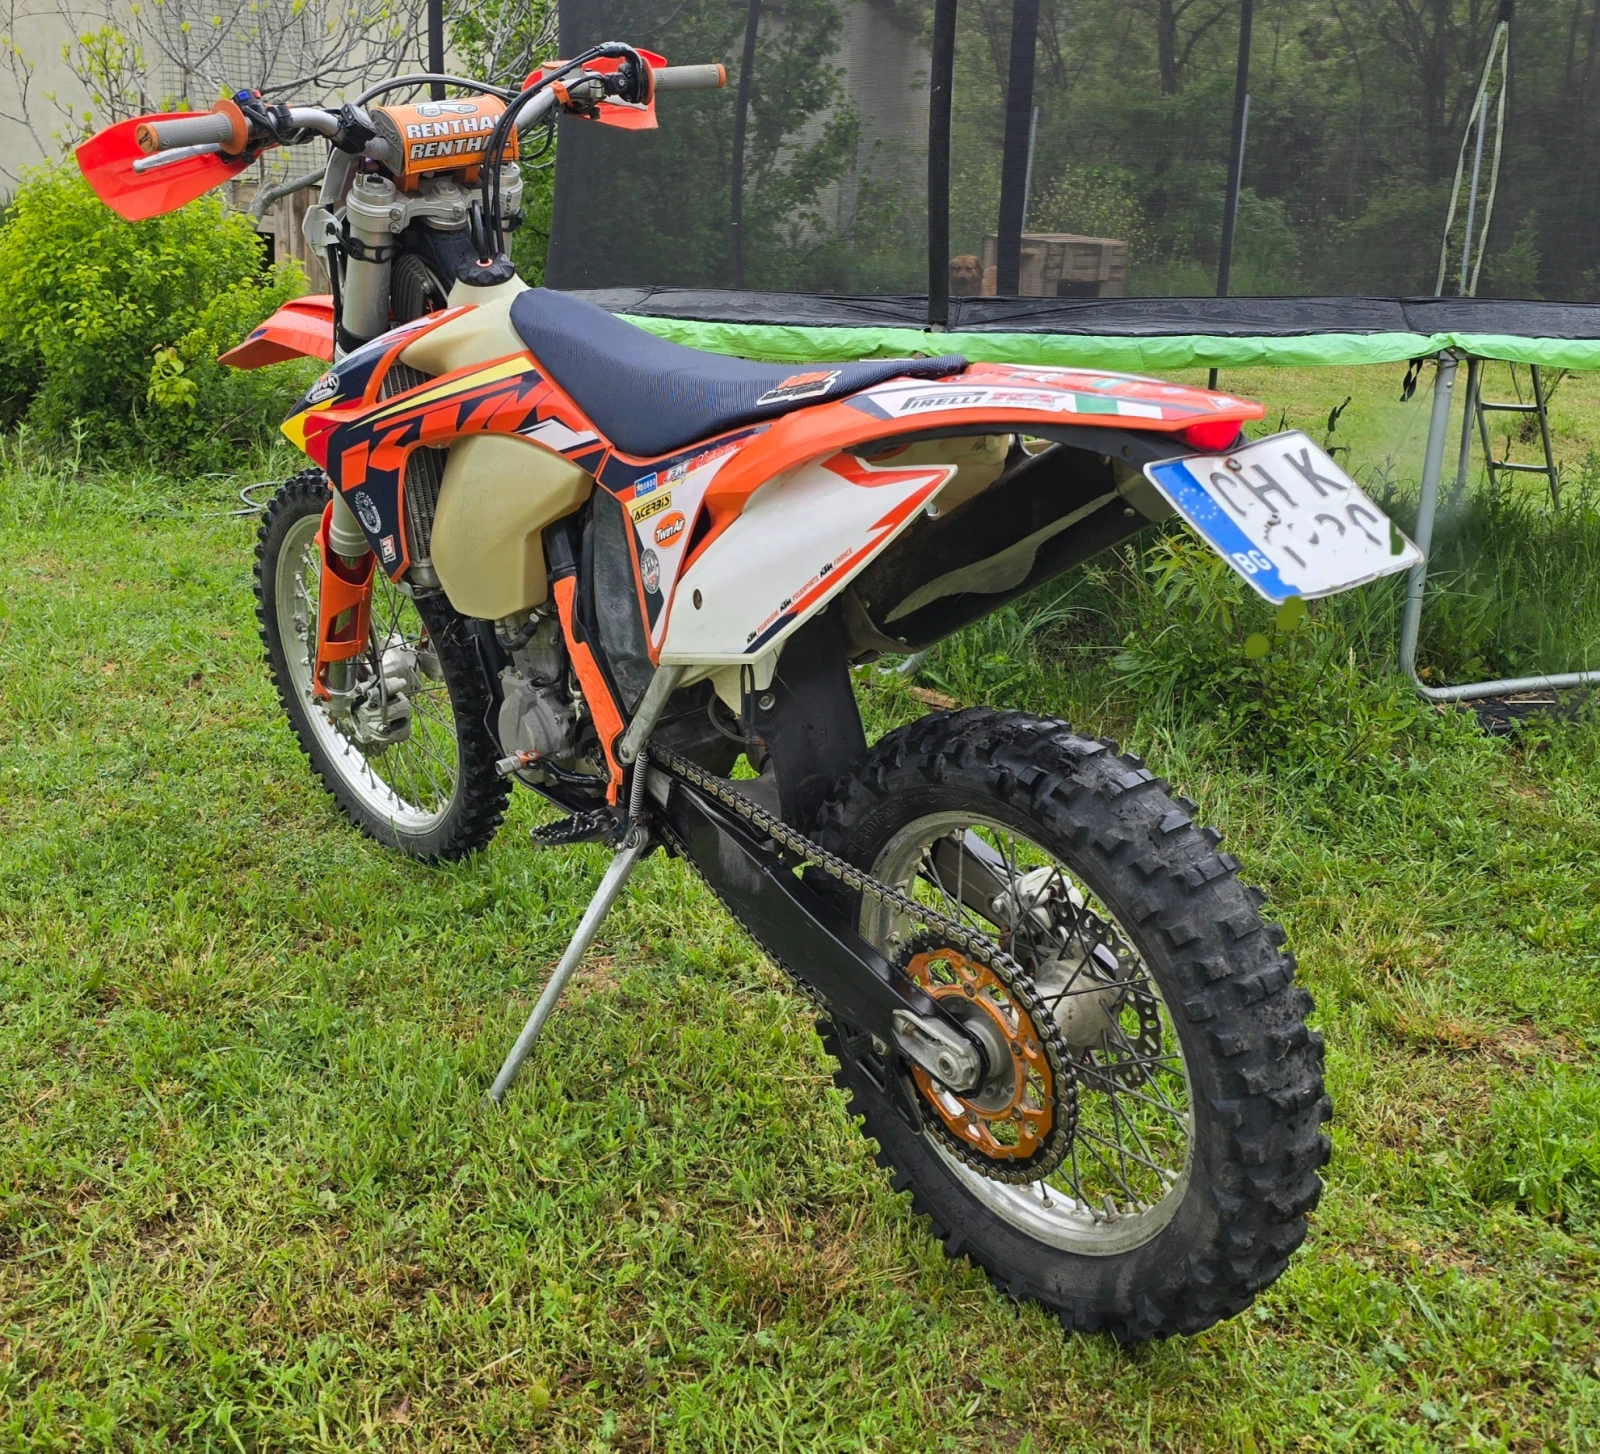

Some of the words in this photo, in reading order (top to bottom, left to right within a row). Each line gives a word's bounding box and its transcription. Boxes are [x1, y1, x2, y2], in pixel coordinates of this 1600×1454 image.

[900, 391, 988, 411] PIRELLI
[1231, 549, 1272, 574] BG
[746, 630, 757, 644] KTM
[780, 598, 792, 612] KTM
[820, 562, 833, 578] KTM
